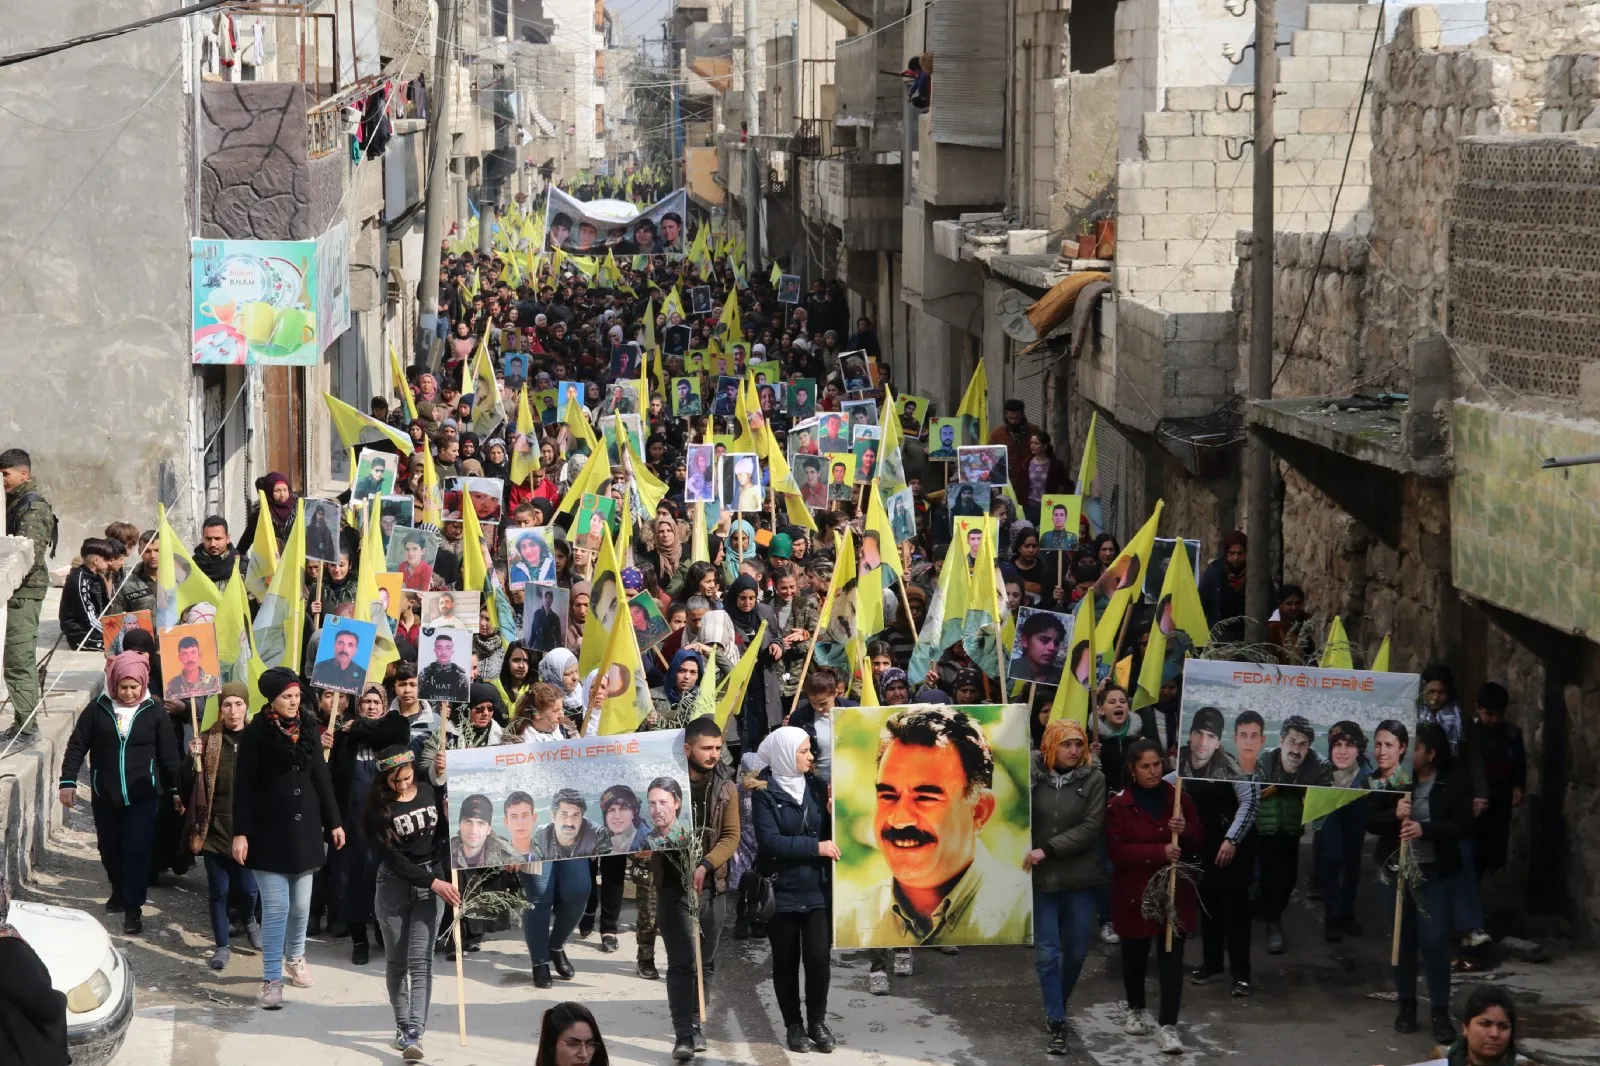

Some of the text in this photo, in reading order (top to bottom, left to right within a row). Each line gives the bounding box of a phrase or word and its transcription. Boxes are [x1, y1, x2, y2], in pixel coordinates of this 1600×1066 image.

[1321, 675, 1375, 693] EFRÎNÊ
[495, 738, 640, 767] FEDAYIYÊN EFRÎNÊ
[393, 805, 438, 836] BTS
